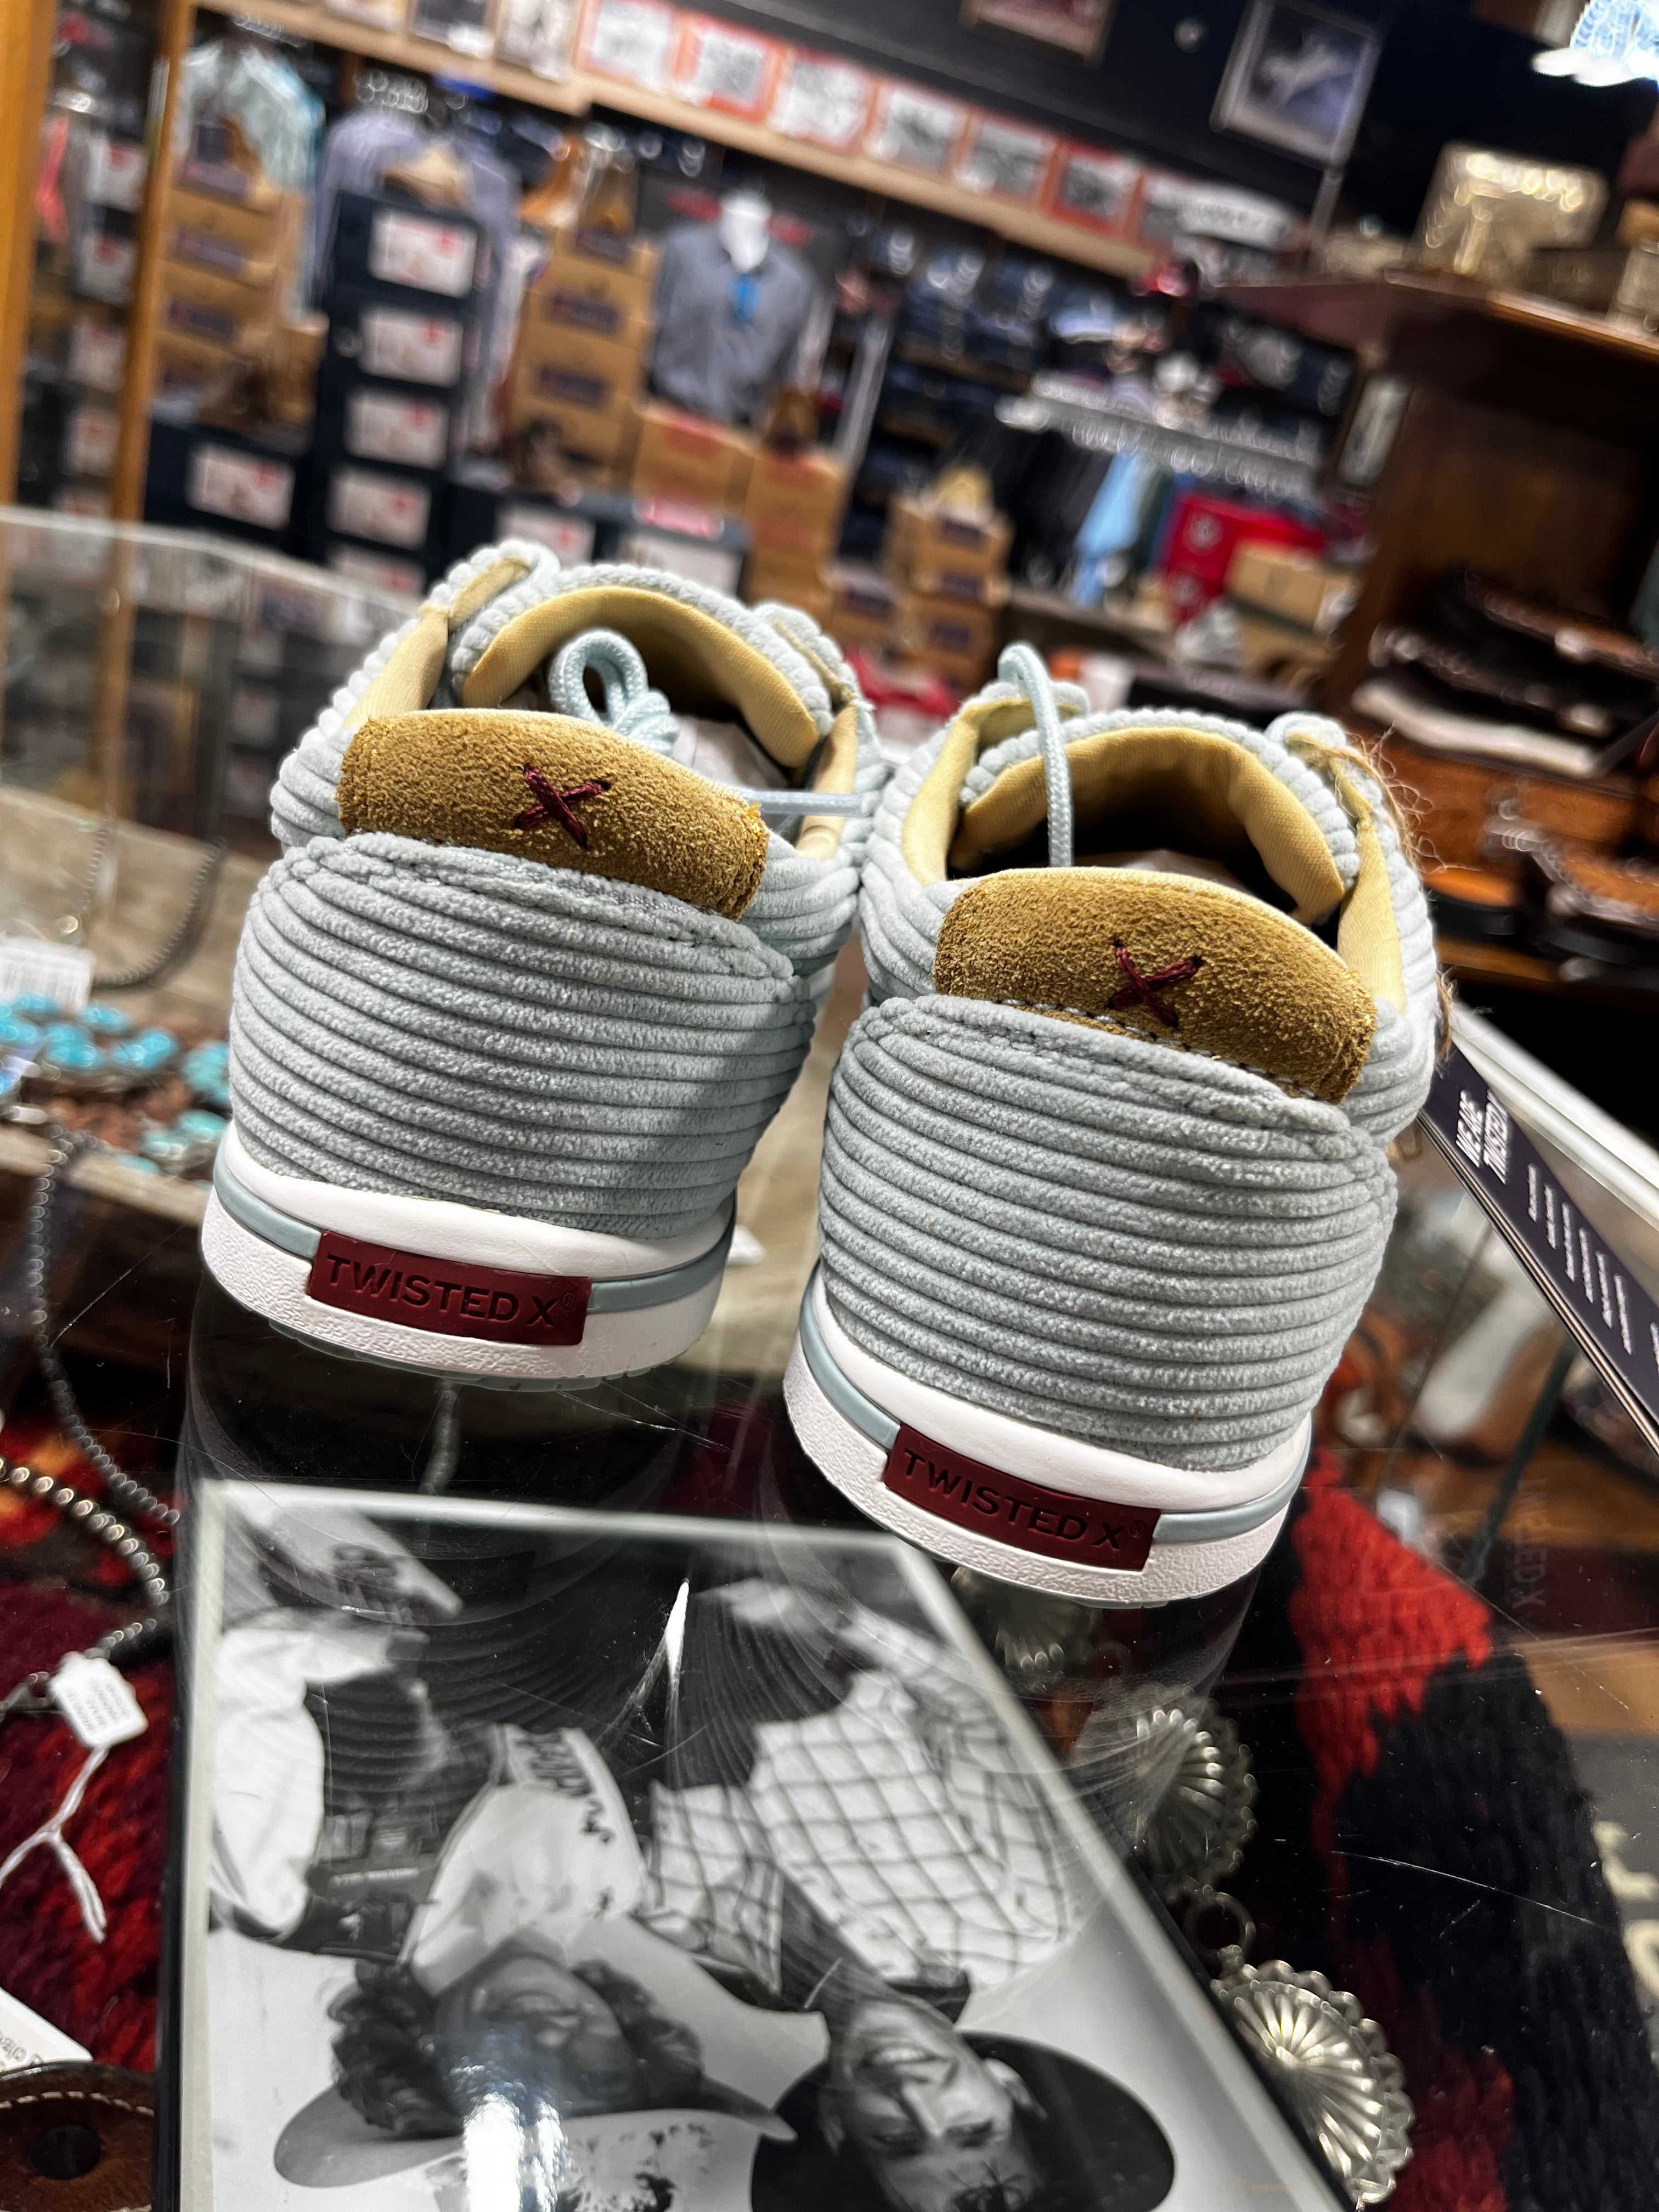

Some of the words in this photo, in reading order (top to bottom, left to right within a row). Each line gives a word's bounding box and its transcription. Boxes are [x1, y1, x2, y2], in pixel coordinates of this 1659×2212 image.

[1456, 1119, 1481, 1169] WE
[1459, 1088, 1483, 1142] ARE
[1483, 1102, 1509, 1185] TWISTED
[326, 1254, 520, 1323] TWISTED
[904, 1448, 1087, 1541] TWISTED
